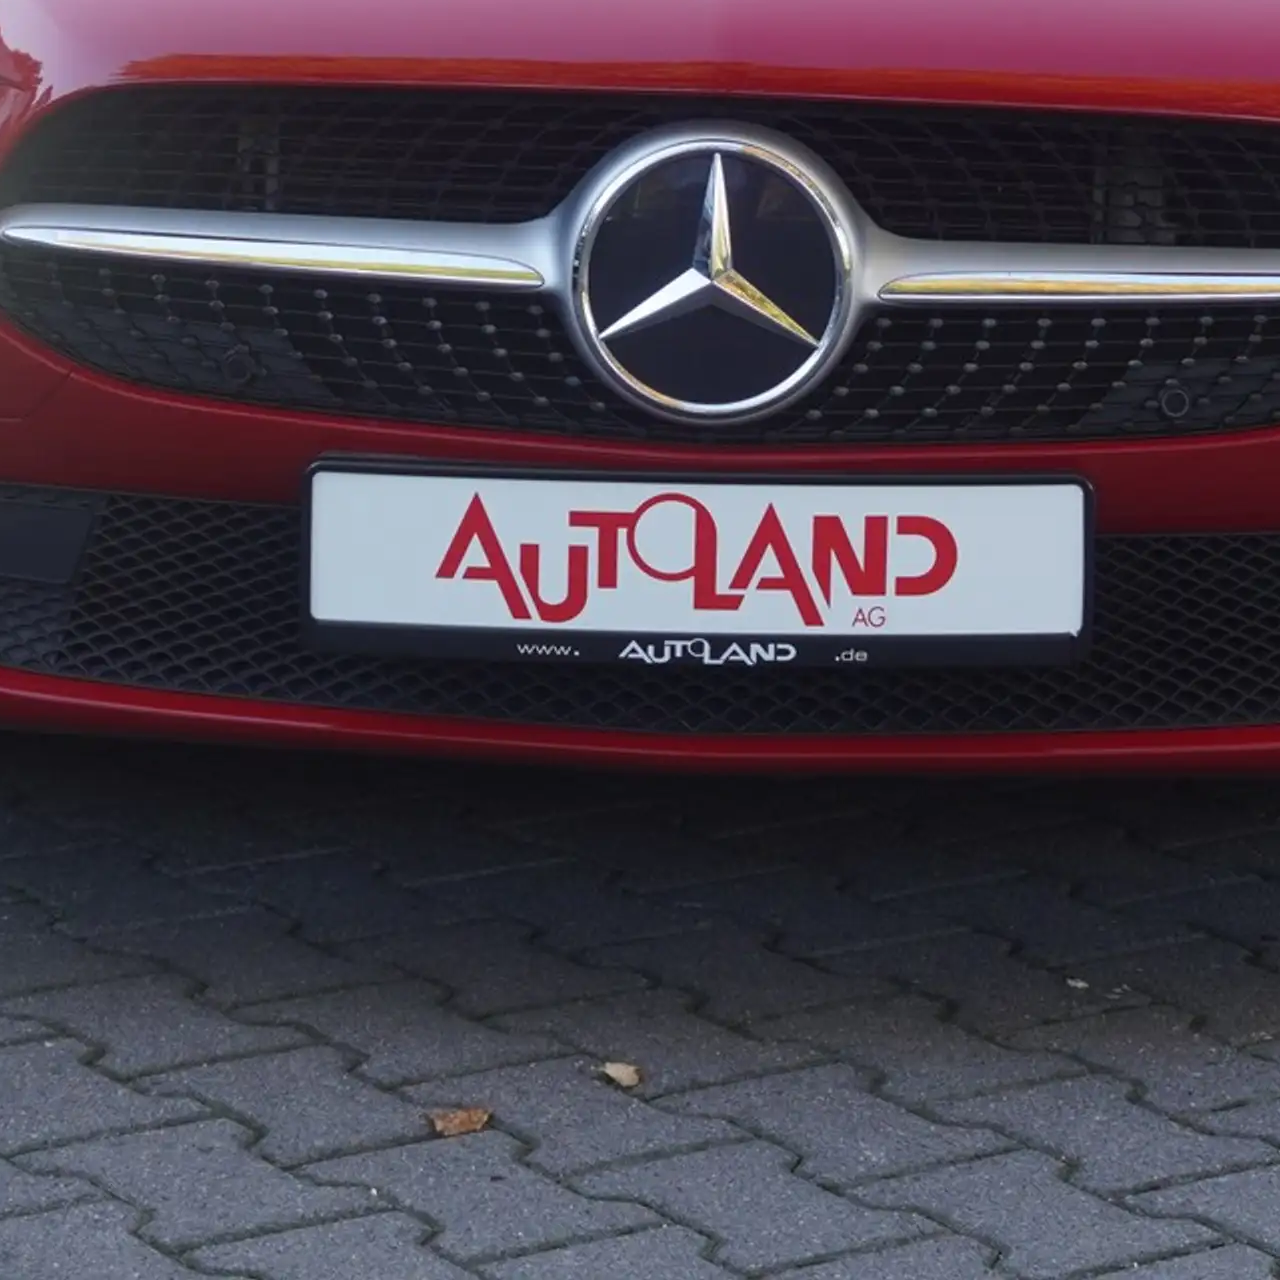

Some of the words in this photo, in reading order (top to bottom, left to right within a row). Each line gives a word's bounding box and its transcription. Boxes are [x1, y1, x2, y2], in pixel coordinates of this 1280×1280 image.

[435, 491, 958, 627] AUTOLAND
[851, 606, 886, 628] AG
[618, 637, 797, 667] AUTOLAND
[834, 647, 868, 662] .de
